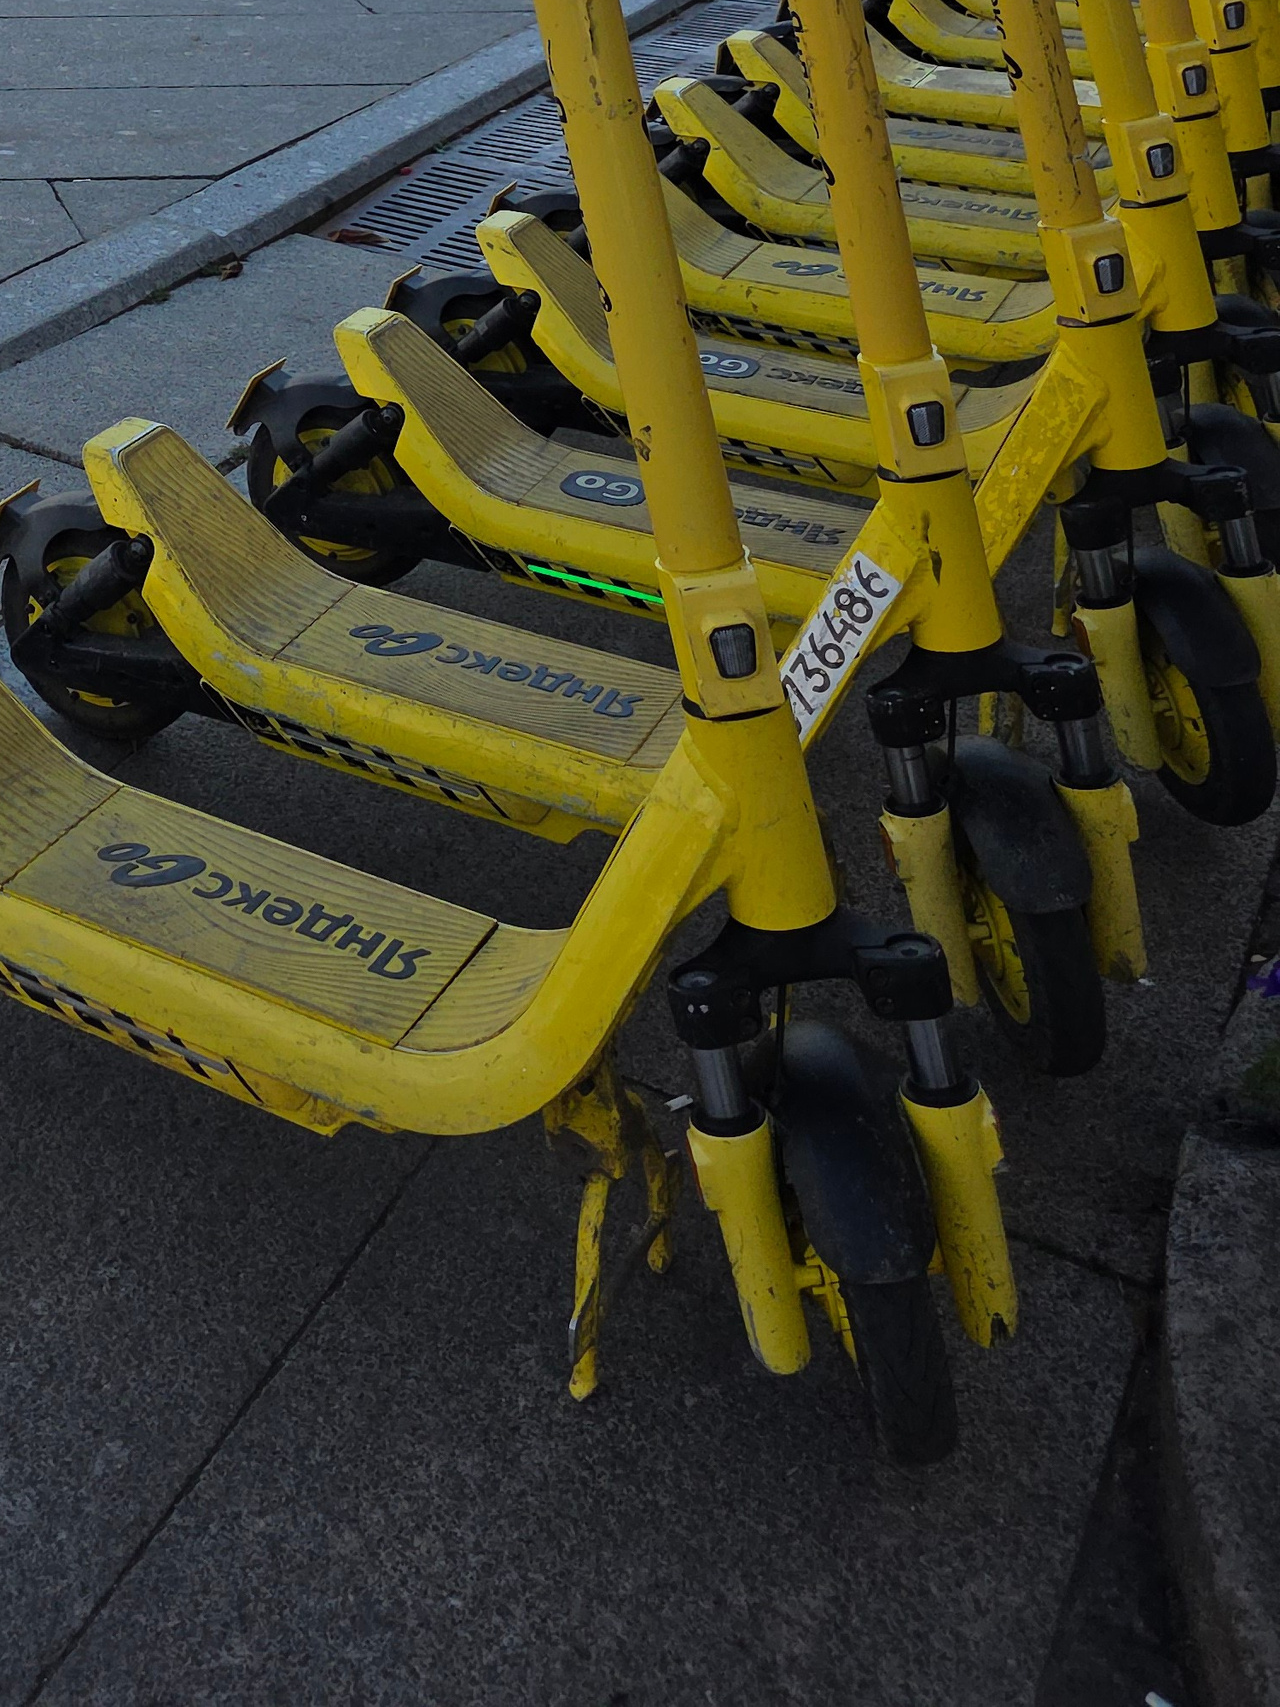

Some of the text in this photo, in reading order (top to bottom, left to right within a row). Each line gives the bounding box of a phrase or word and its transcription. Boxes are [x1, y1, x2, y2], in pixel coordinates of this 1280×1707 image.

[772, 260, 838, 276] Go
[575, 475, 639, 500] Go
[349, 625, 644, 718] Яндекс Go
[782, 559, 890, 735] 136486
[97, 842, 432, 980] Яндекс Go
